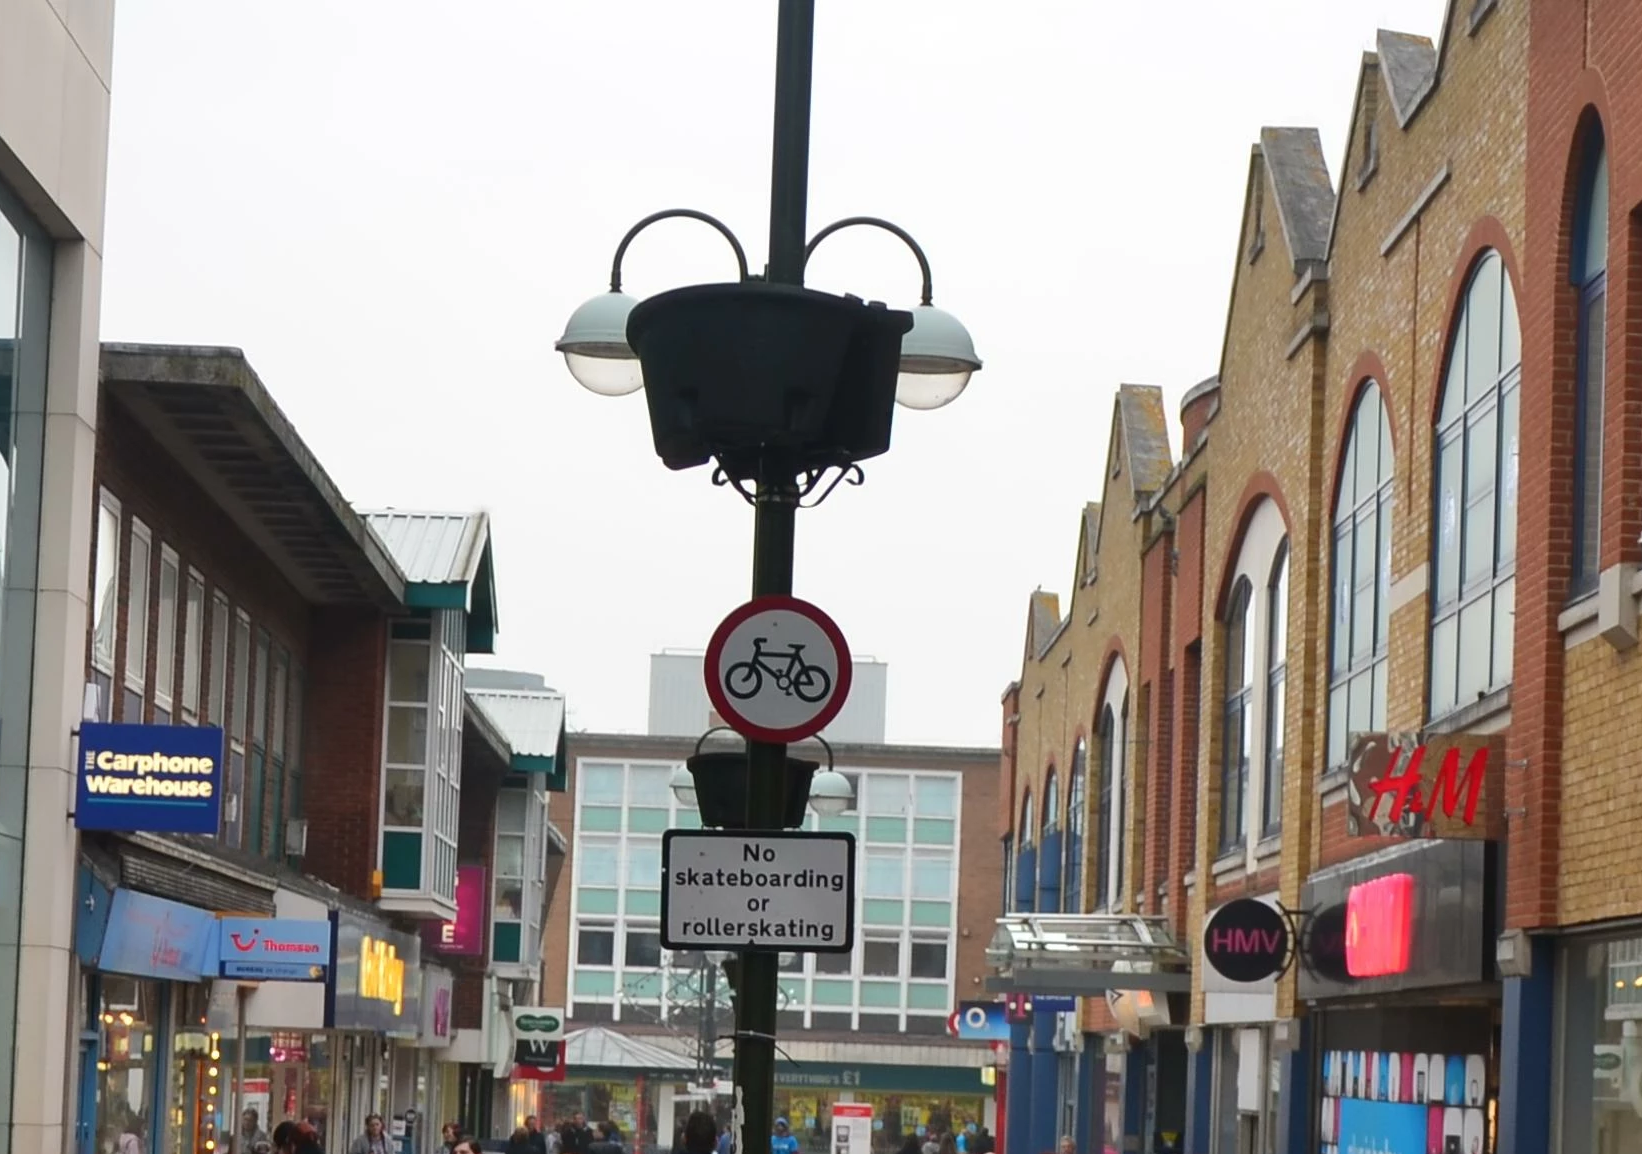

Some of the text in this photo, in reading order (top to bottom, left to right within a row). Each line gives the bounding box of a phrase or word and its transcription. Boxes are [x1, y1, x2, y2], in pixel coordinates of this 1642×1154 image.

[97, 750, 214, 775] Carphone
[85, 775, 213, 799] Warehouse
[1367, 744, 1490, 826] H&M
[743, 843, 776, 863] No
[674, 867, 845, 892] skateboarding
[746, 897, 770, 912] or
[681, 917, 835, 942] rollerskating
[1212, 927, 1281, 954] HMV
[262, 939, 320, 954] Thomson
